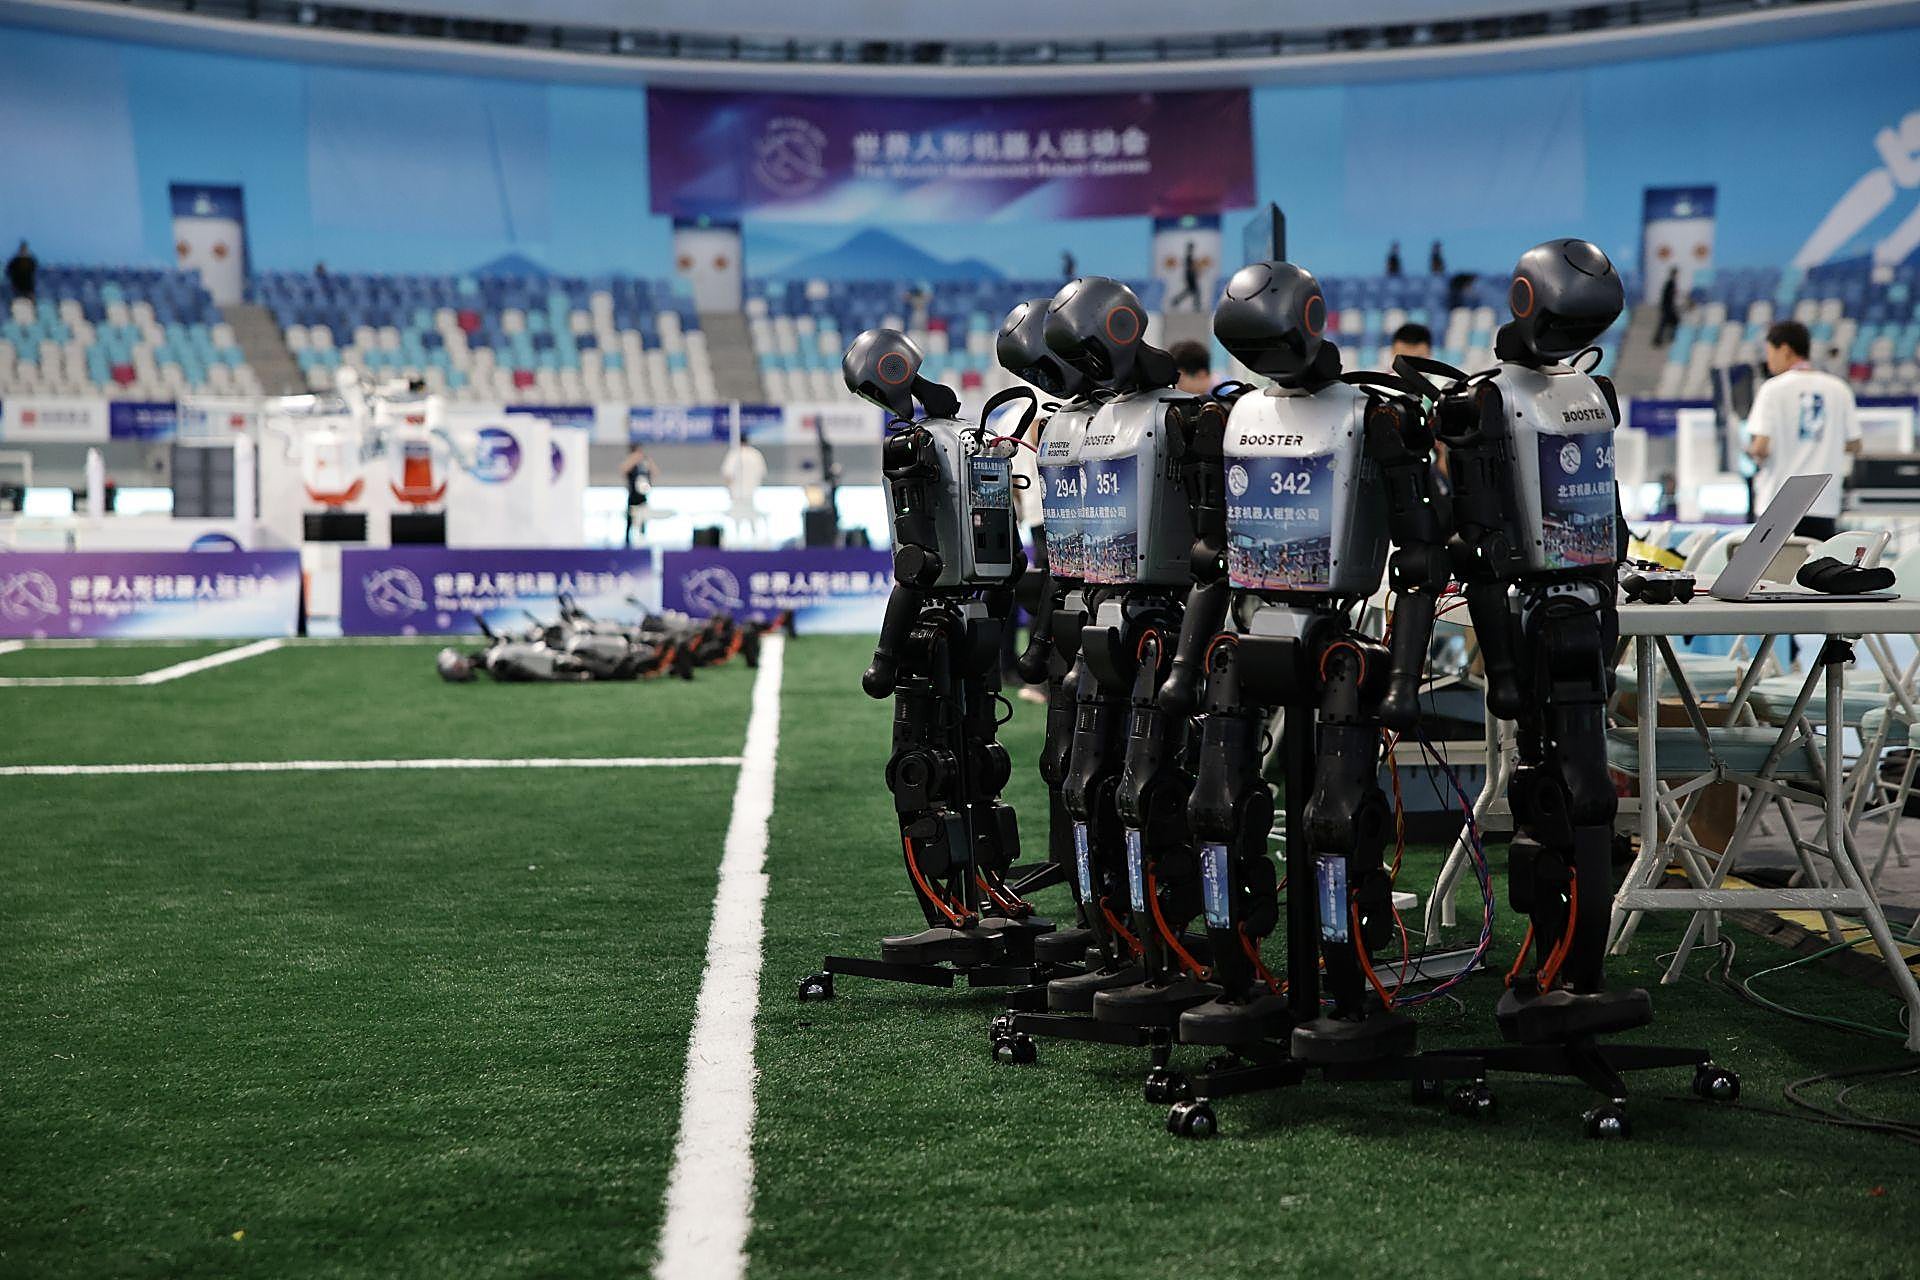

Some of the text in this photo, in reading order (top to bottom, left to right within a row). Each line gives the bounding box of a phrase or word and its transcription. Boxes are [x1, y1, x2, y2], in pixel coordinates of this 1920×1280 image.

[1562, 409, 1607, 423] BOOSTER
[1083, 435, 1116, 446] BOOSTER
[1239, 435, 1304, 446] BOOSTER
[1047, 449, 1070, 457] ROBOTICS
[1055, 478, 1078, 498] 294
[1096, 473, 1120, 495] 351
[1269, 472, 1312, 495] 342
